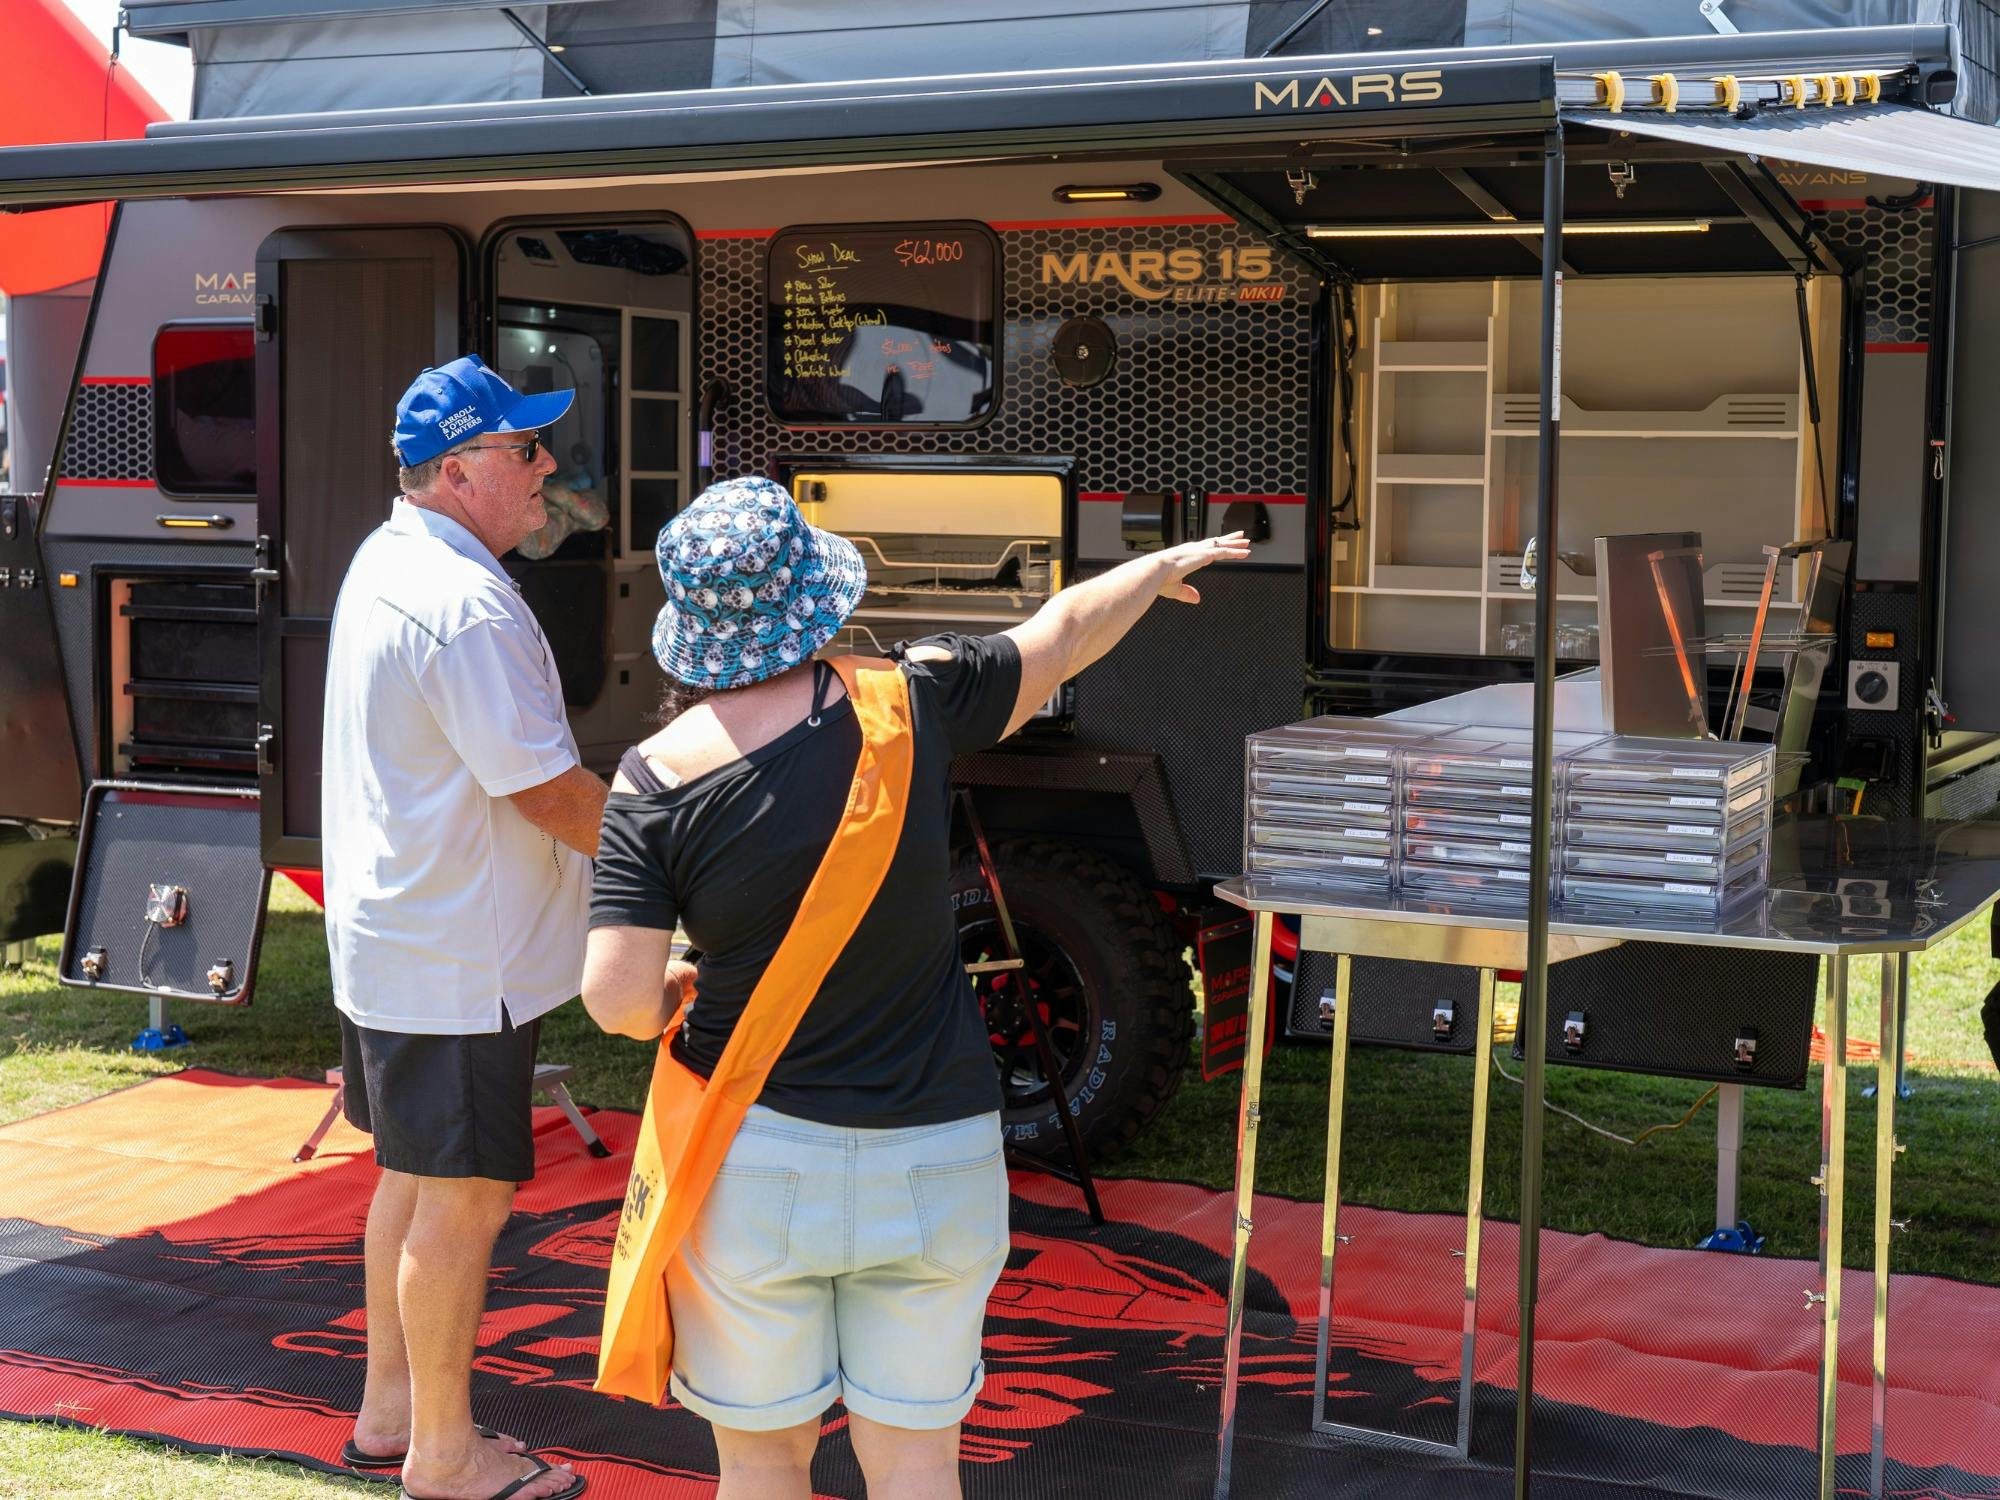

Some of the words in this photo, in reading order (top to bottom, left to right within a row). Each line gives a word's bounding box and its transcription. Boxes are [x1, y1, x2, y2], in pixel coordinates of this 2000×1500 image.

[1255, 70, 1443, 110] MARS
[1776, 172, 1867, 185] AVANS
[894, 239, 963, 267] $62,000
[1042, 249, 1202, 299] MARS
[1217, 248, 1272, 280] 15
[438, 405, 476, 428] CARROLL
[445, 416, 483, 440] LAWYERS
[449, 414, 475, 430] O'DEA
[1048, 1019, 1117, 1130] RADIAL
[629, 1165, 650, 1221] CK
